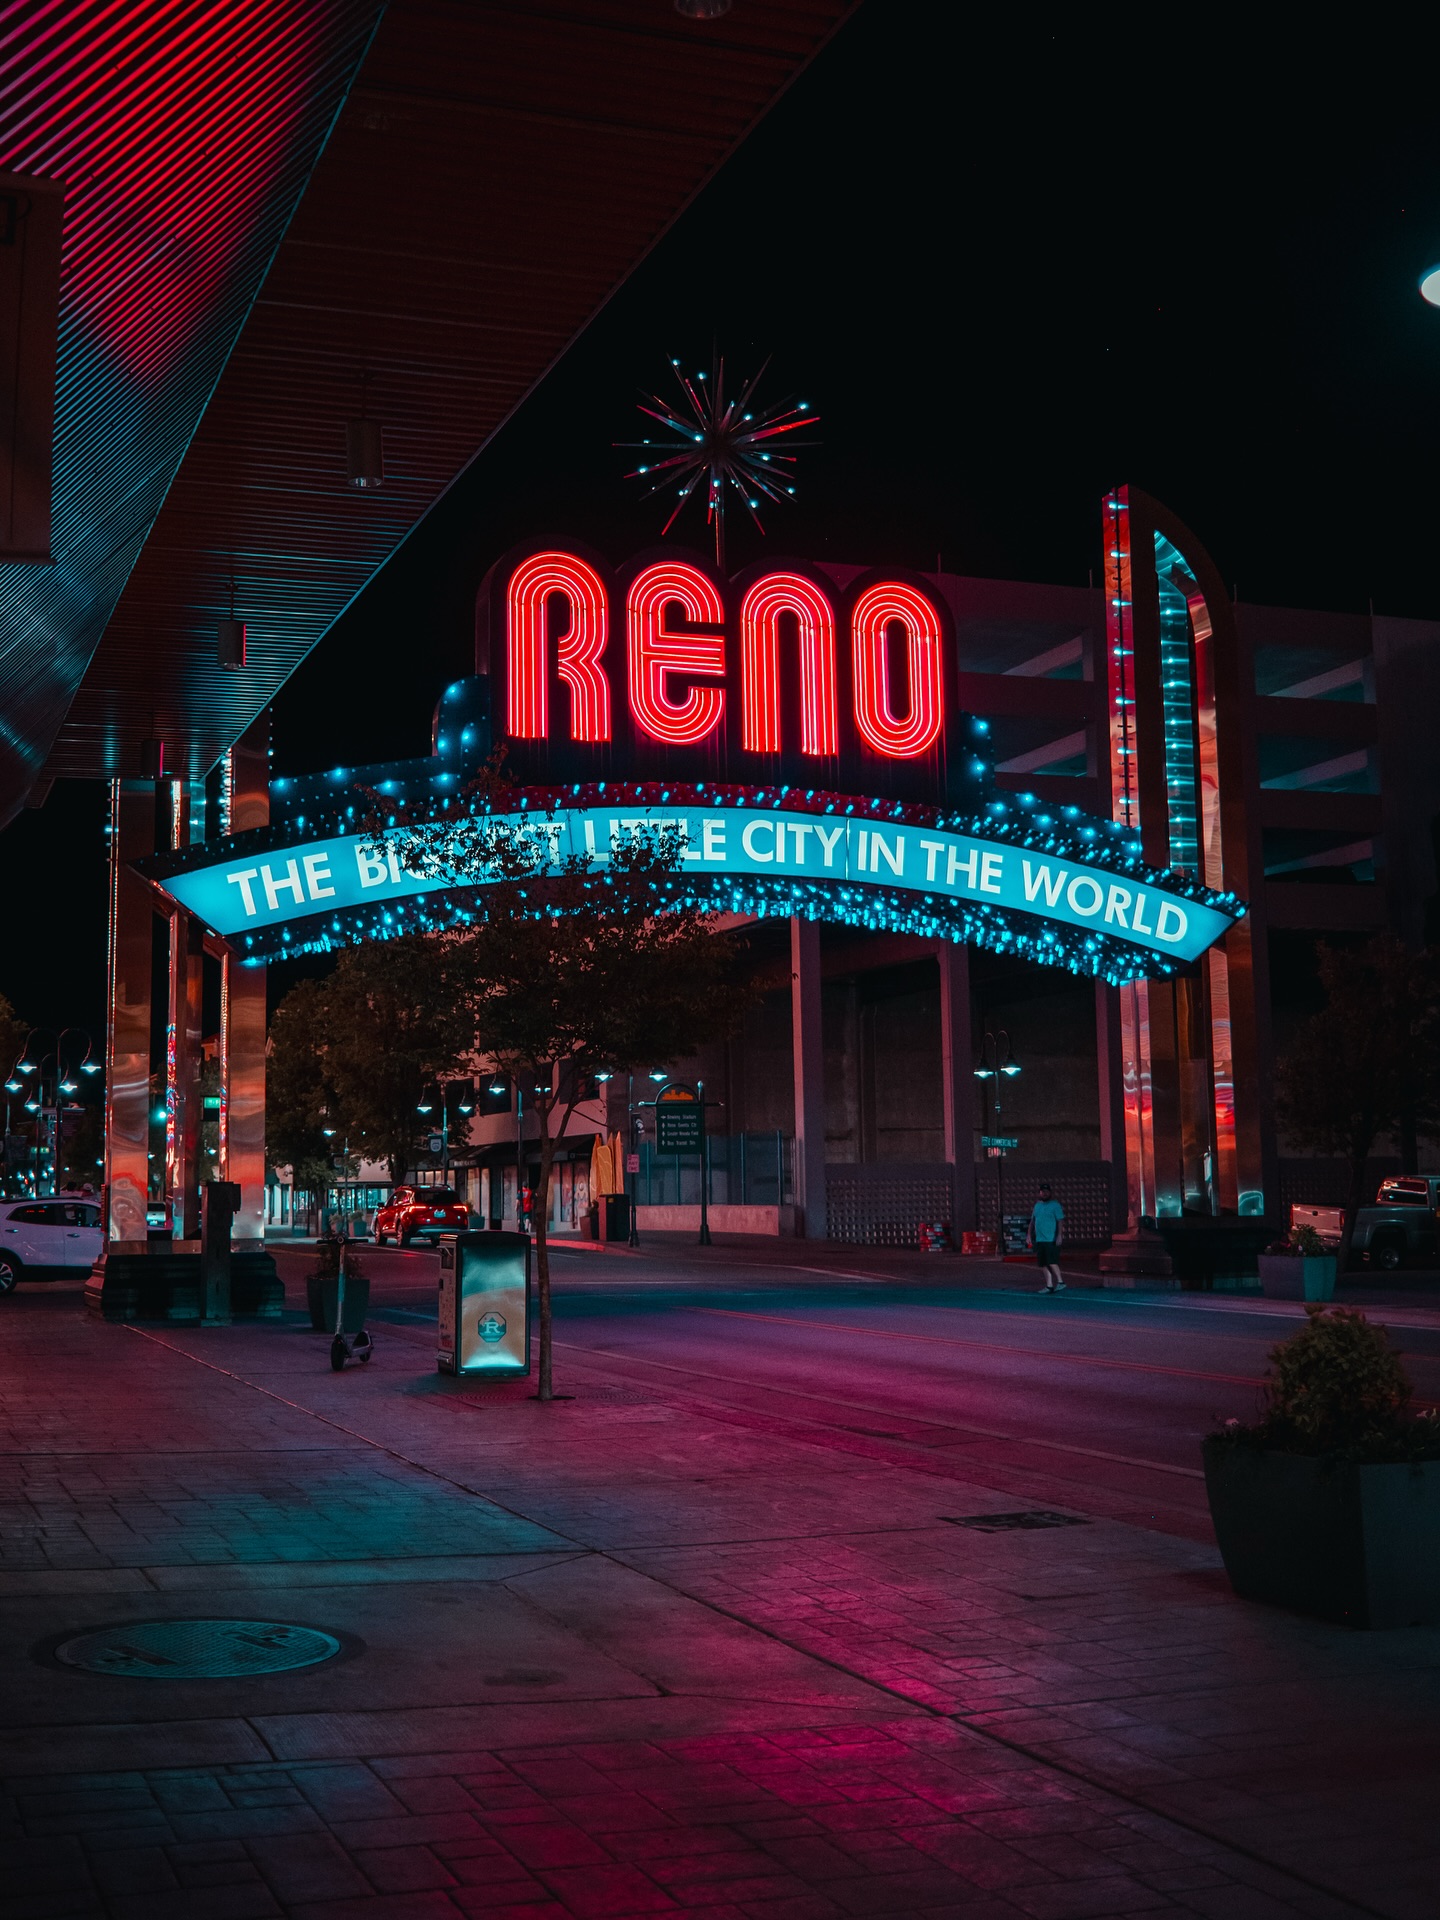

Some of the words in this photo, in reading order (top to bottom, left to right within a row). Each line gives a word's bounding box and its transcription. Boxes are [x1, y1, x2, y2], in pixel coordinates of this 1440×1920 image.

[507, 551, 944, 758] RENO
[227, 852, 336, 916] THE
[584, 819, 727, 862] LITTLE
[741, 819, 848, 867] CITY
[857, 830, 904, 876] IN
[920, 840, 1004, 894] THE
[1022, 859, 1188, 943] WORLD
[484, 1321, 500, 1334] R
